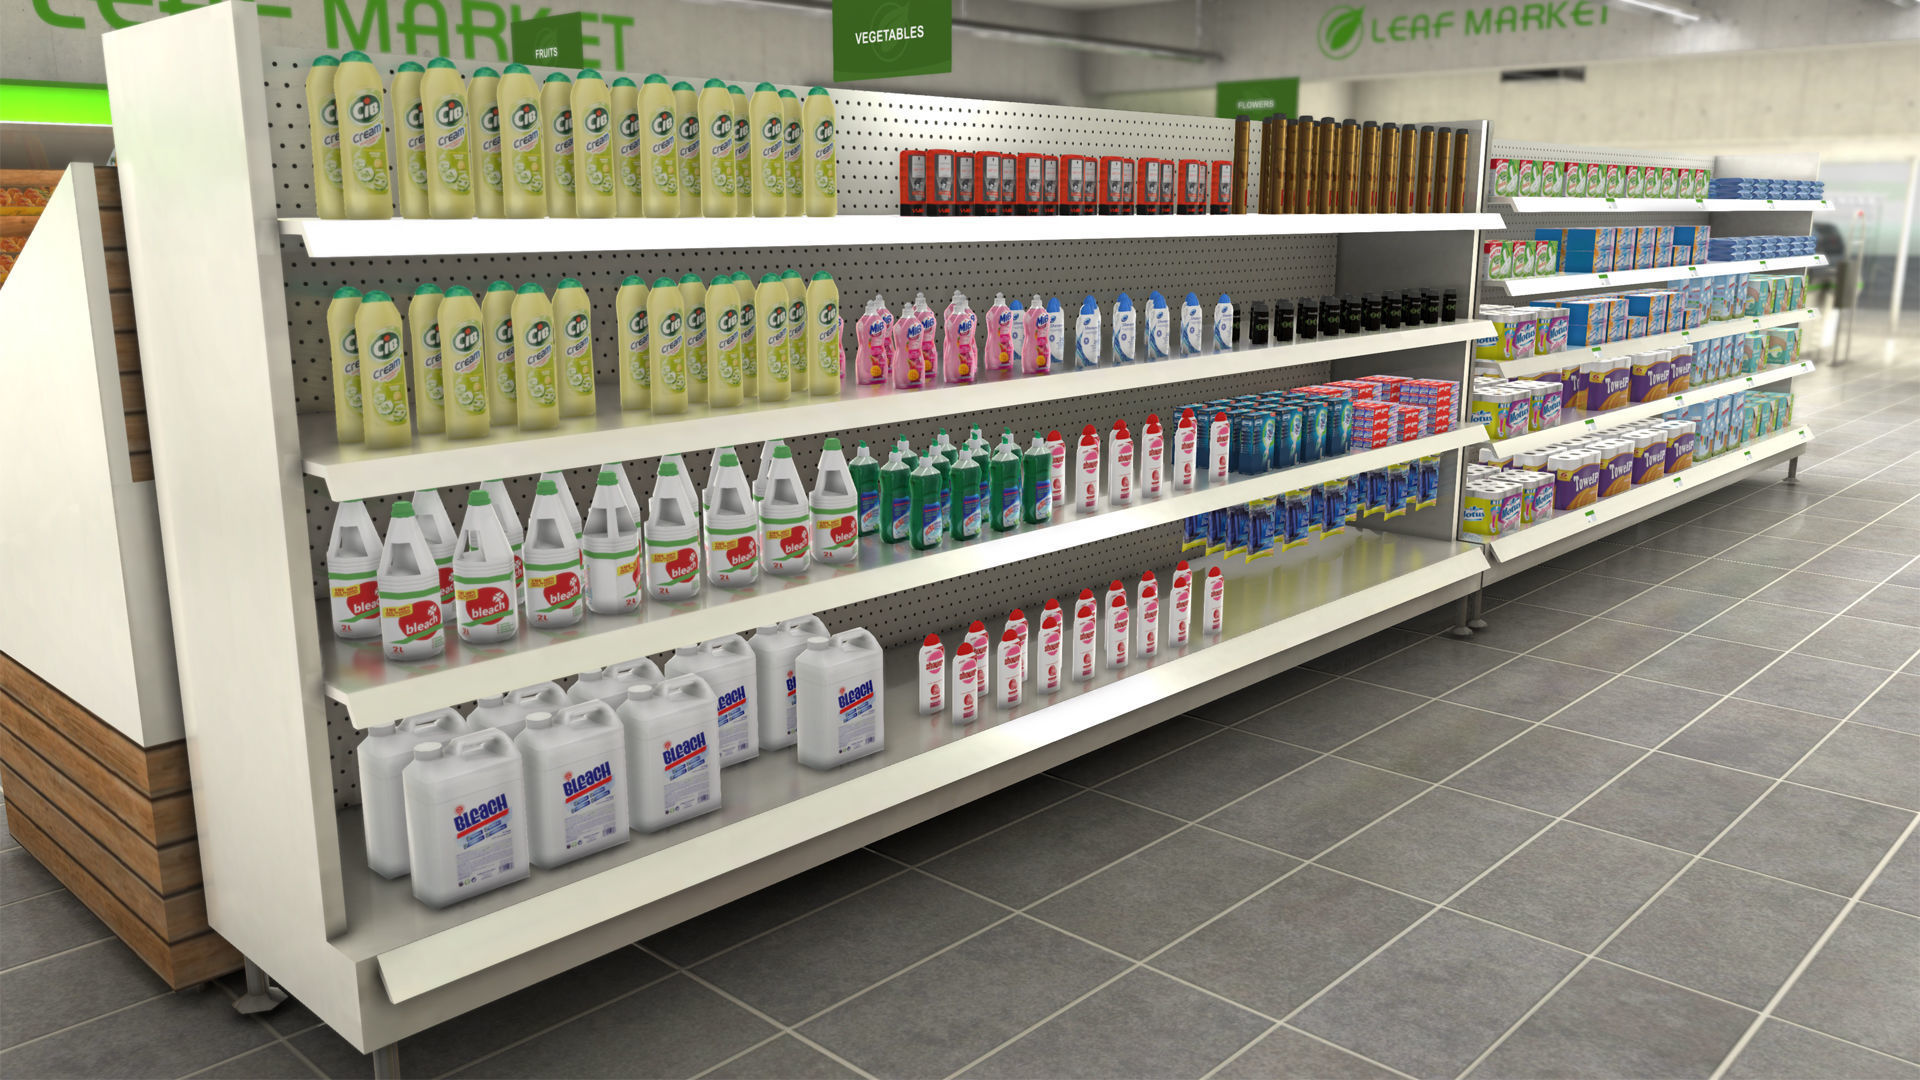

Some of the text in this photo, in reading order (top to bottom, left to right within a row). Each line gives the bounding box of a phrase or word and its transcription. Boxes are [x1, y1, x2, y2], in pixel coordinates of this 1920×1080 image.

[322, 0, 634, 71] MARET
[855, 25, 924, 44] VEGETABLES
[1371, 11, 1455, 43] LEAF
[535, 47, 558, 59] FRUITS
[1237, 99, 1274, 110] FLOWERS
[732, 549, 756, 565] bleach
[671, 561, 697, 578] bleach
[550, 585, 578, 604] bleach
[354, 600, 380, 614] bleac
[471, 601, 506, 618] bleach
[405, 615, 439, 635] bleach
